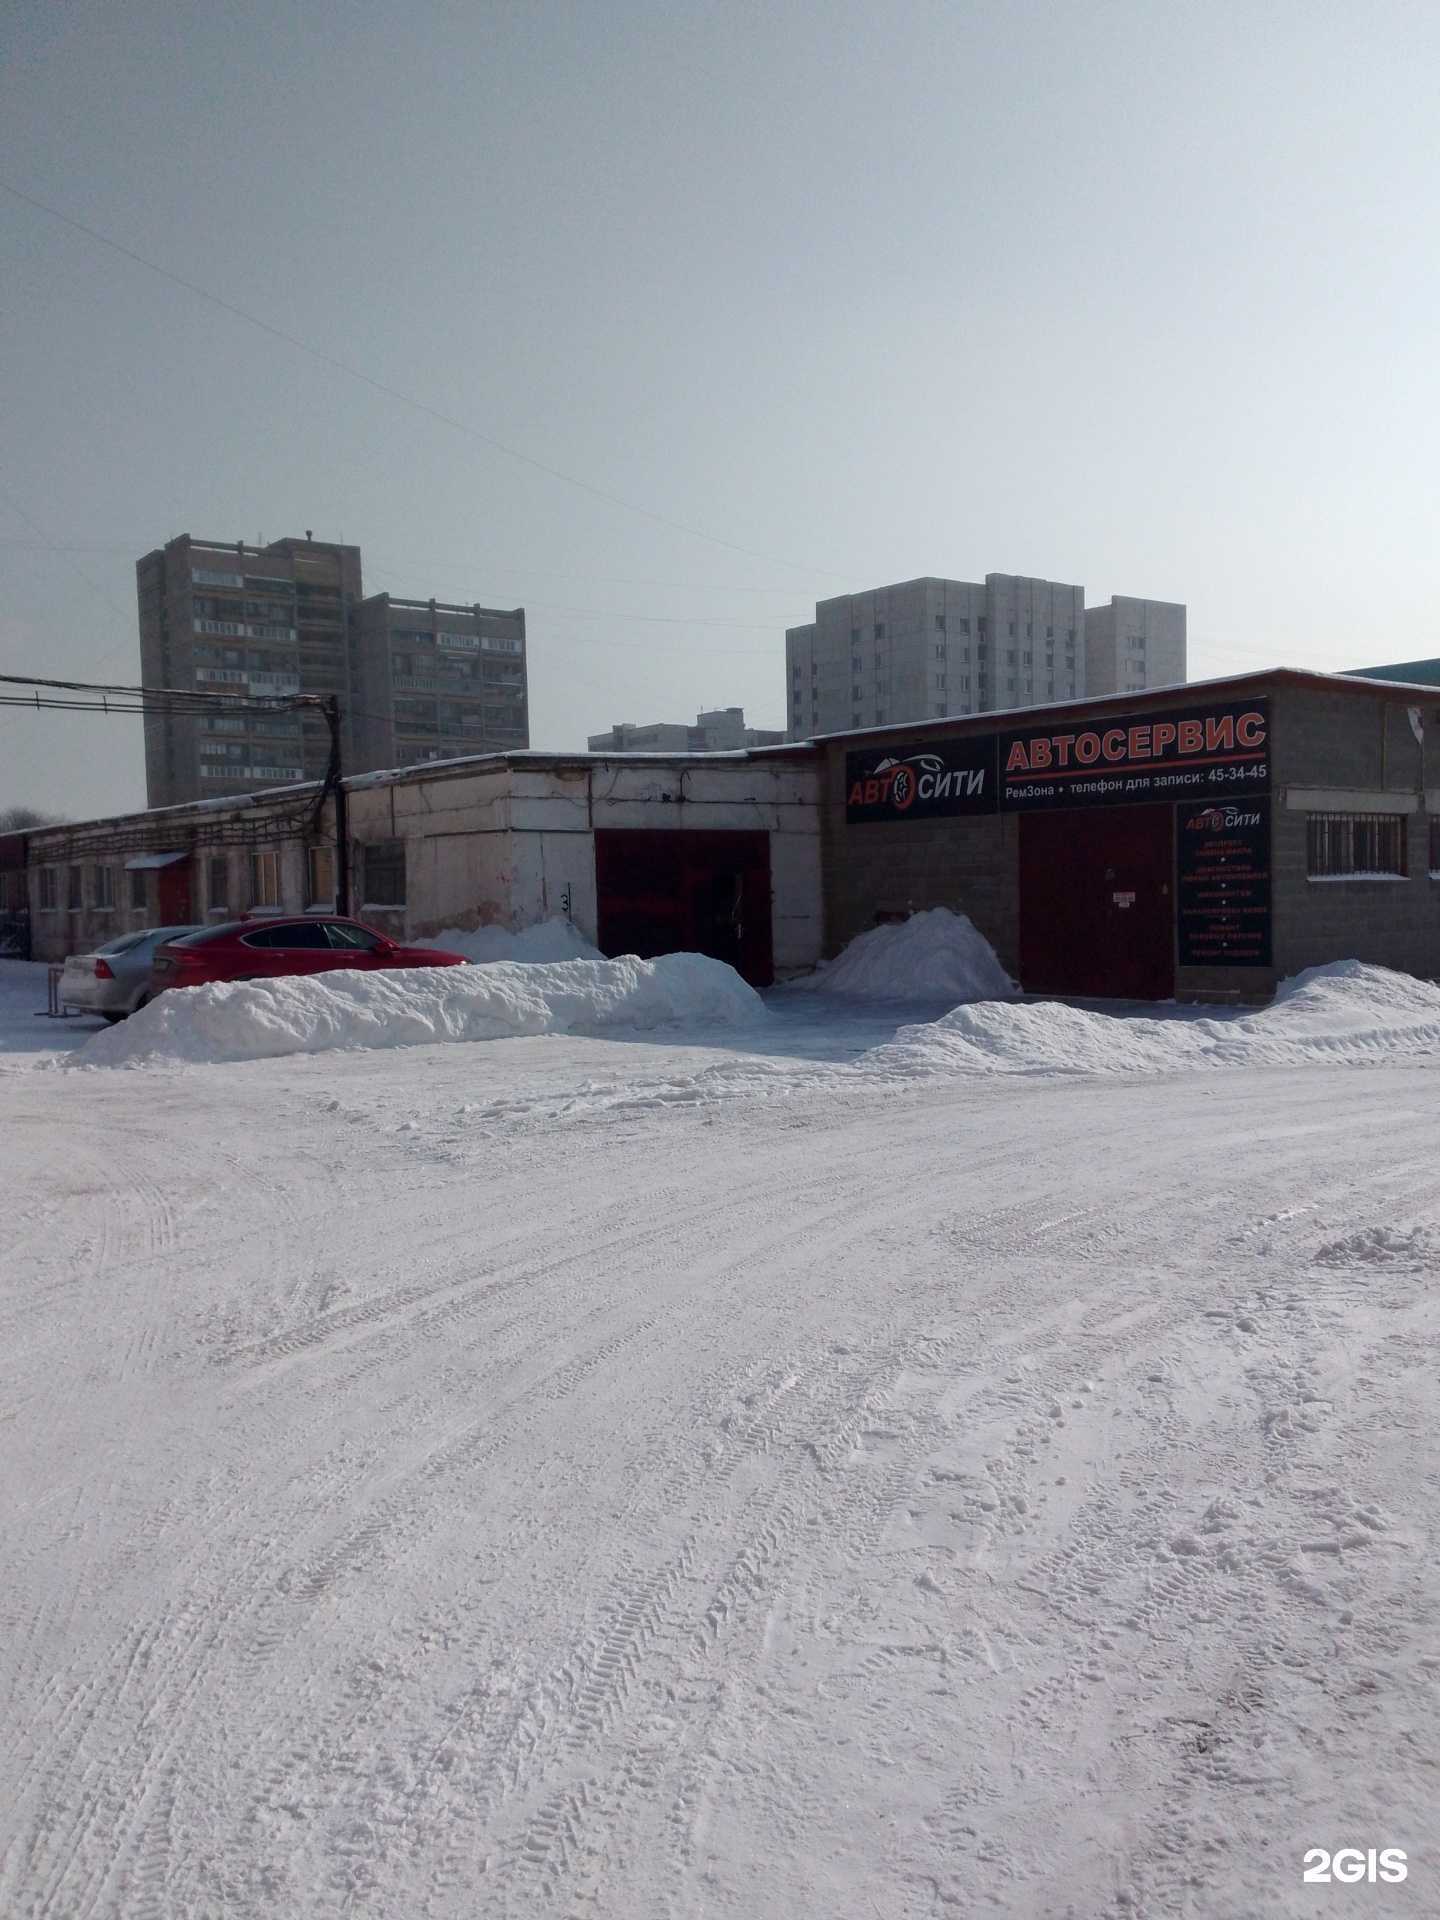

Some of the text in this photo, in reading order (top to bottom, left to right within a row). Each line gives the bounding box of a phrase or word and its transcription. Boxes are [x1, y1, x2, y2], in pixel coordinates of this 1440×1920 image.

[1006, 712, 1266, 771] АВТОСЕРВИС
[1006, 764, 1267, 799] РемЗона телефон для записи: 45-34-45
